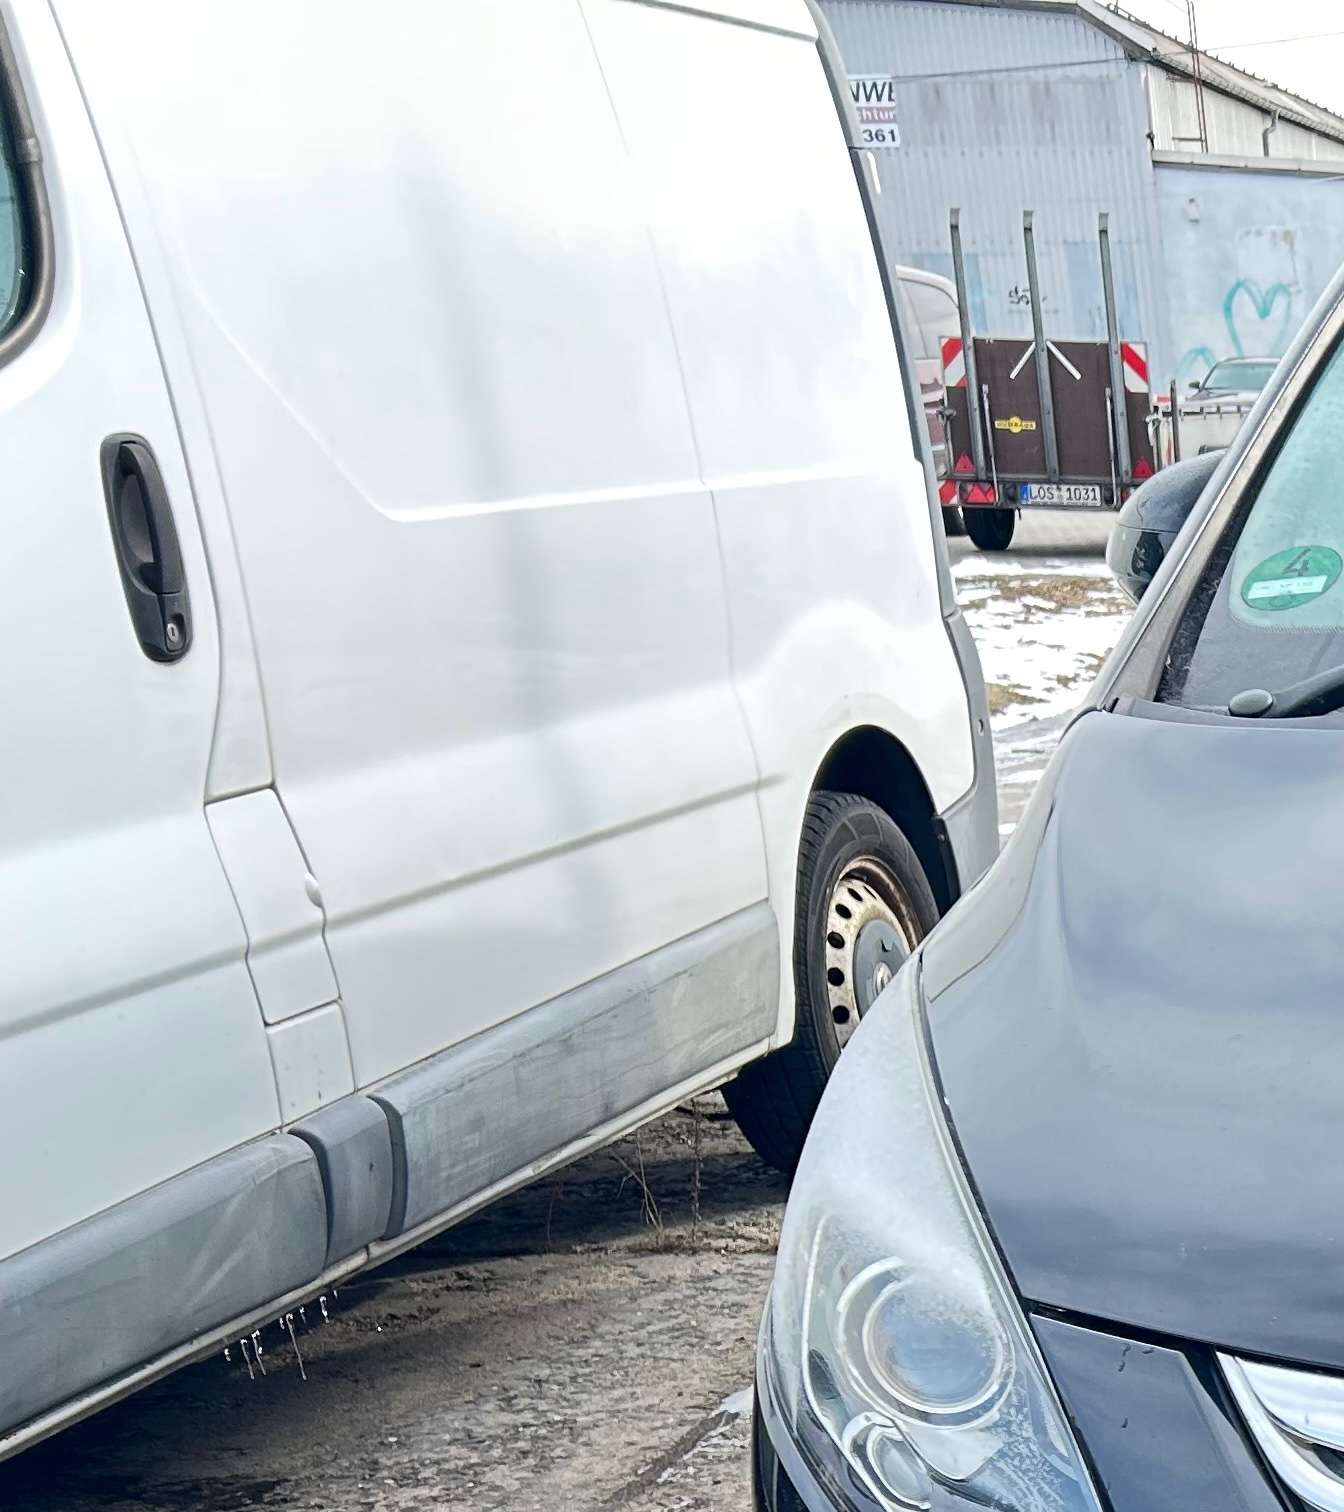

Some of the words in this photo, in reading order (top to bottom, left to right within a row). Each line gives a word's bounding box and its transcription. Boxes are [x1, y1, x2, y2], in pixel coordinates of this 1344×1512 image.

[862, 128, 896, 143] 361
[1029, 486, 1054, 501] LOS
[1066, 487, 1098, 502] 1031
[1282, 548, 1311, 577] 4
